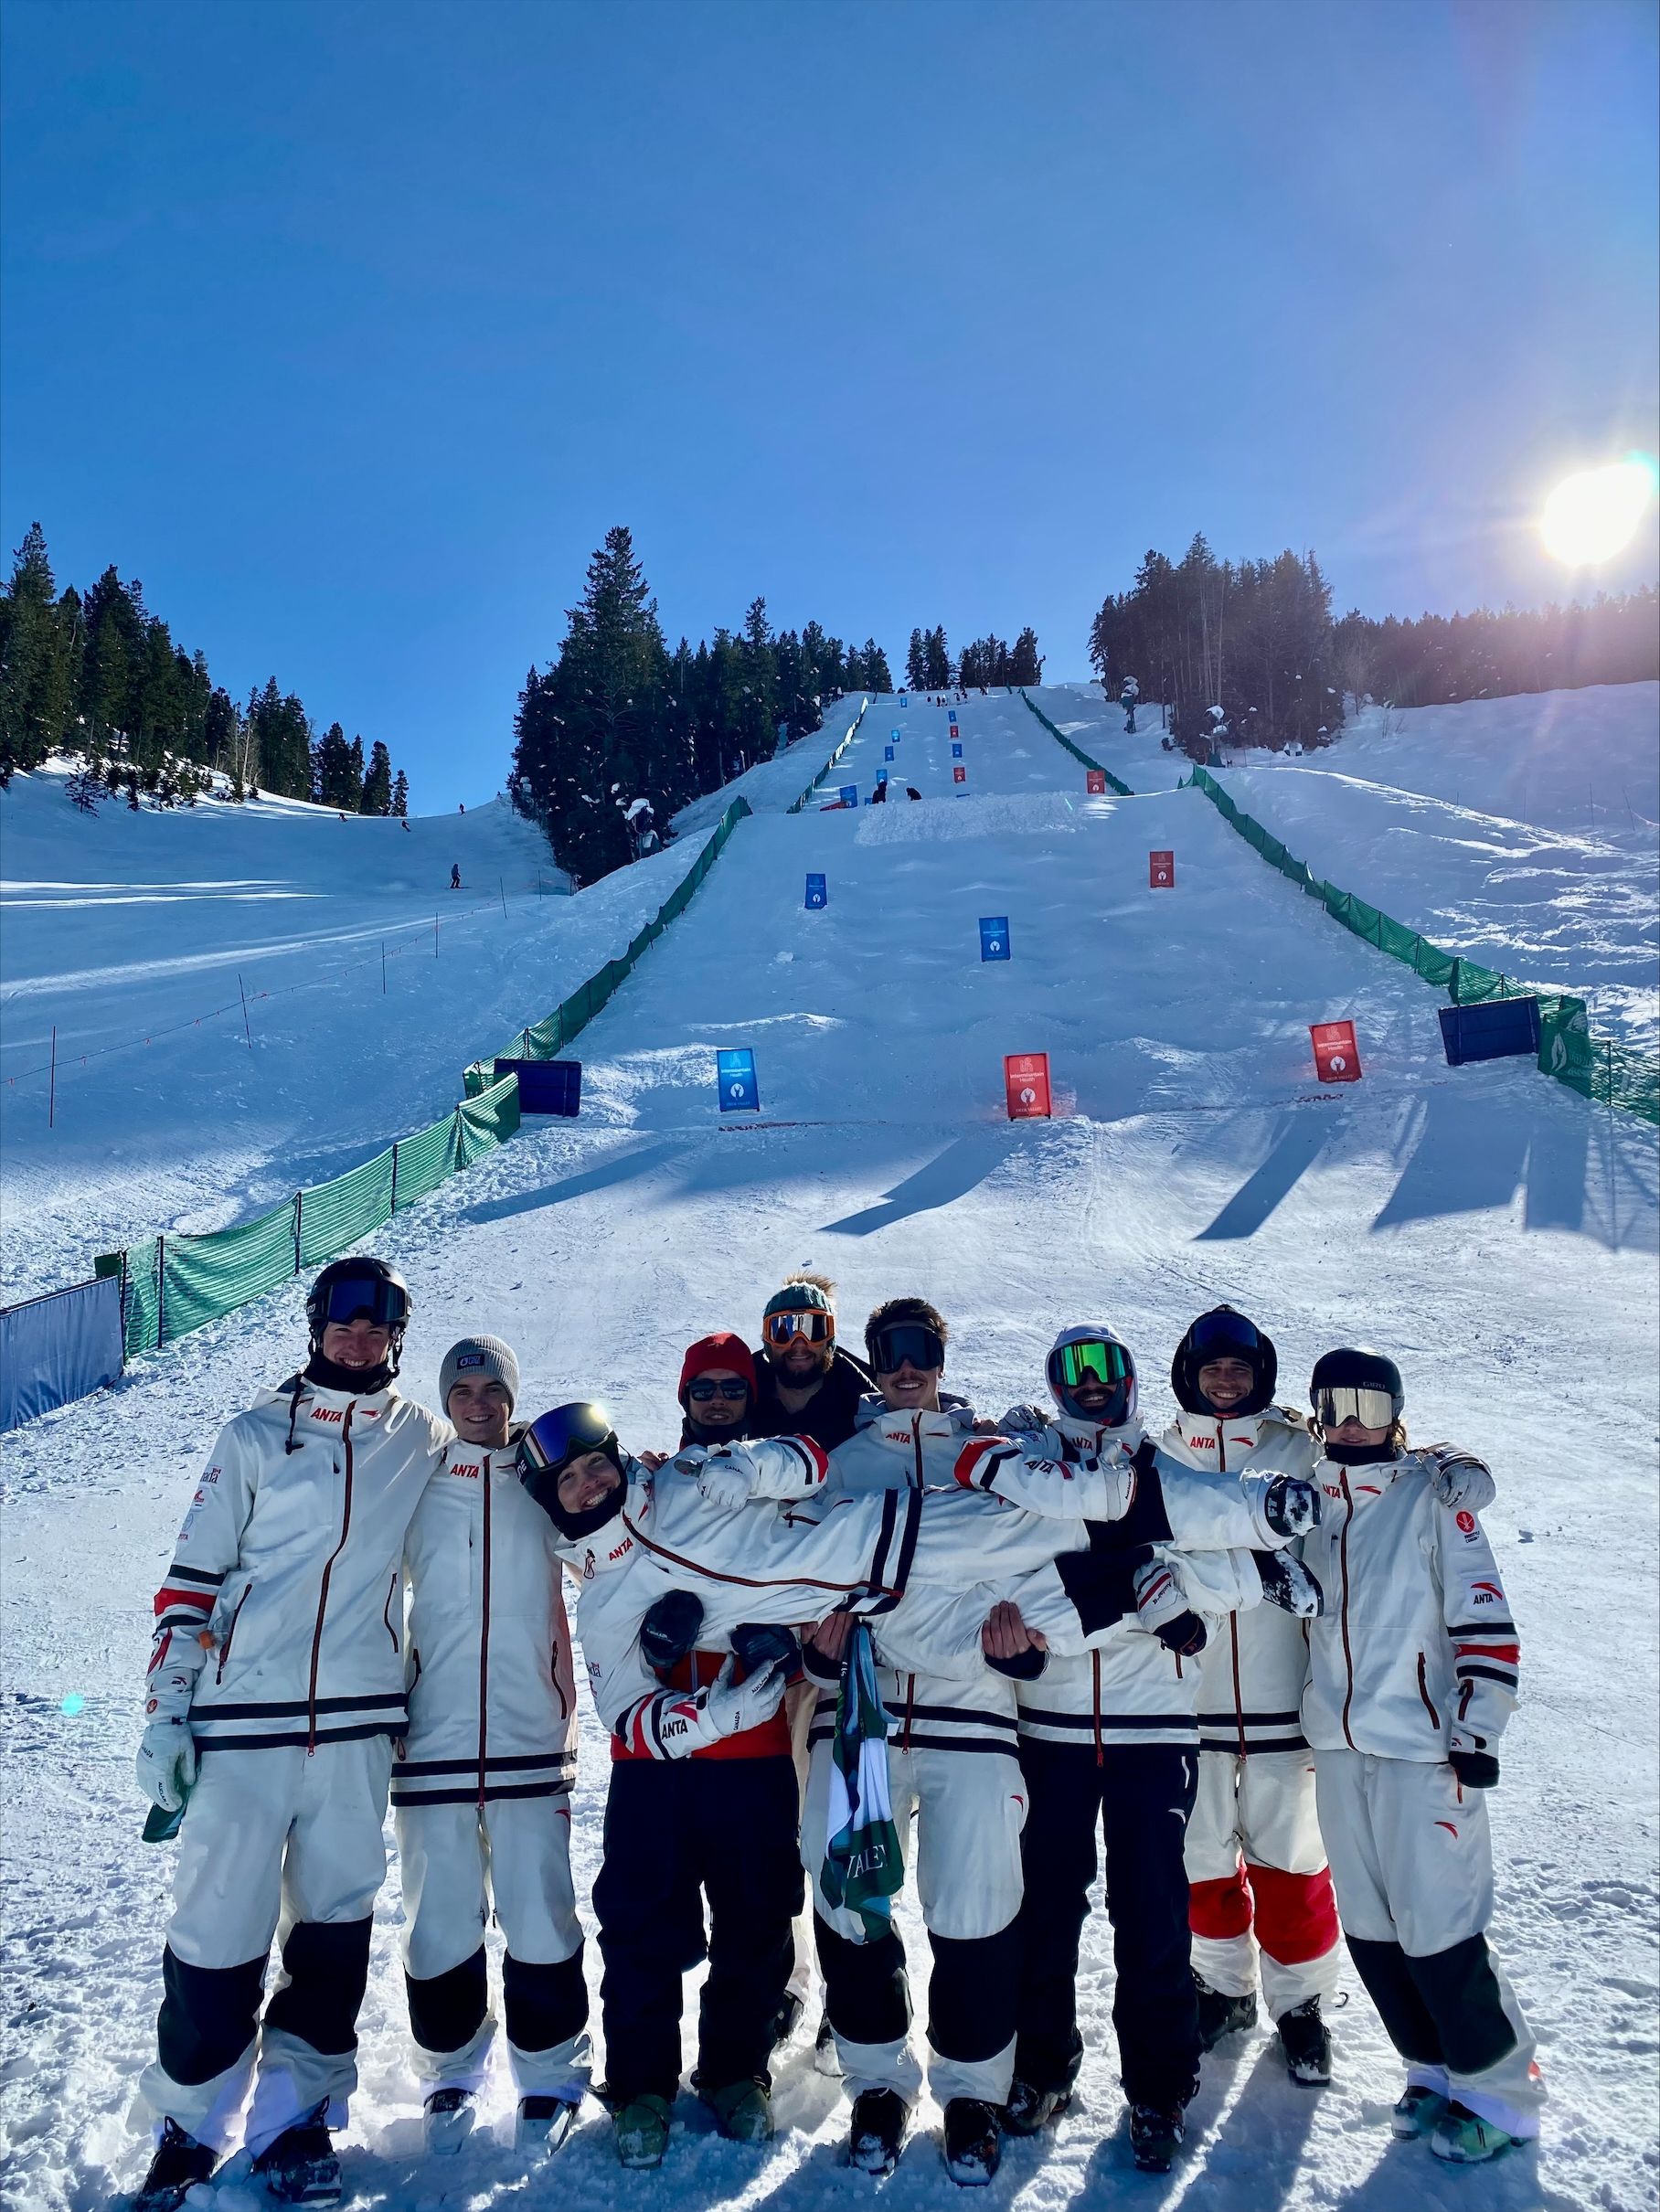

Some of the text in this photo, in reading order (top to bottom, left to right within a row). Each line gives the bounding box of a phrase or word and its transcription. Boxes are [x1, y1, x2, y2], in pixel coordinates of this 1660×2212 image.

[310, 1408, 344, 1423] ANTA
[885, 1432, 911, 1444] ANTA
[1189, 1436, 1215, 1450] ANTA
[450, 1463, 480, 1479] ANTA
[608, 1537, 633, 1561] ANTA
[1473, 1593, 1495, 1605] ANTA
[661, 1718, 688, 1739] ANTA
